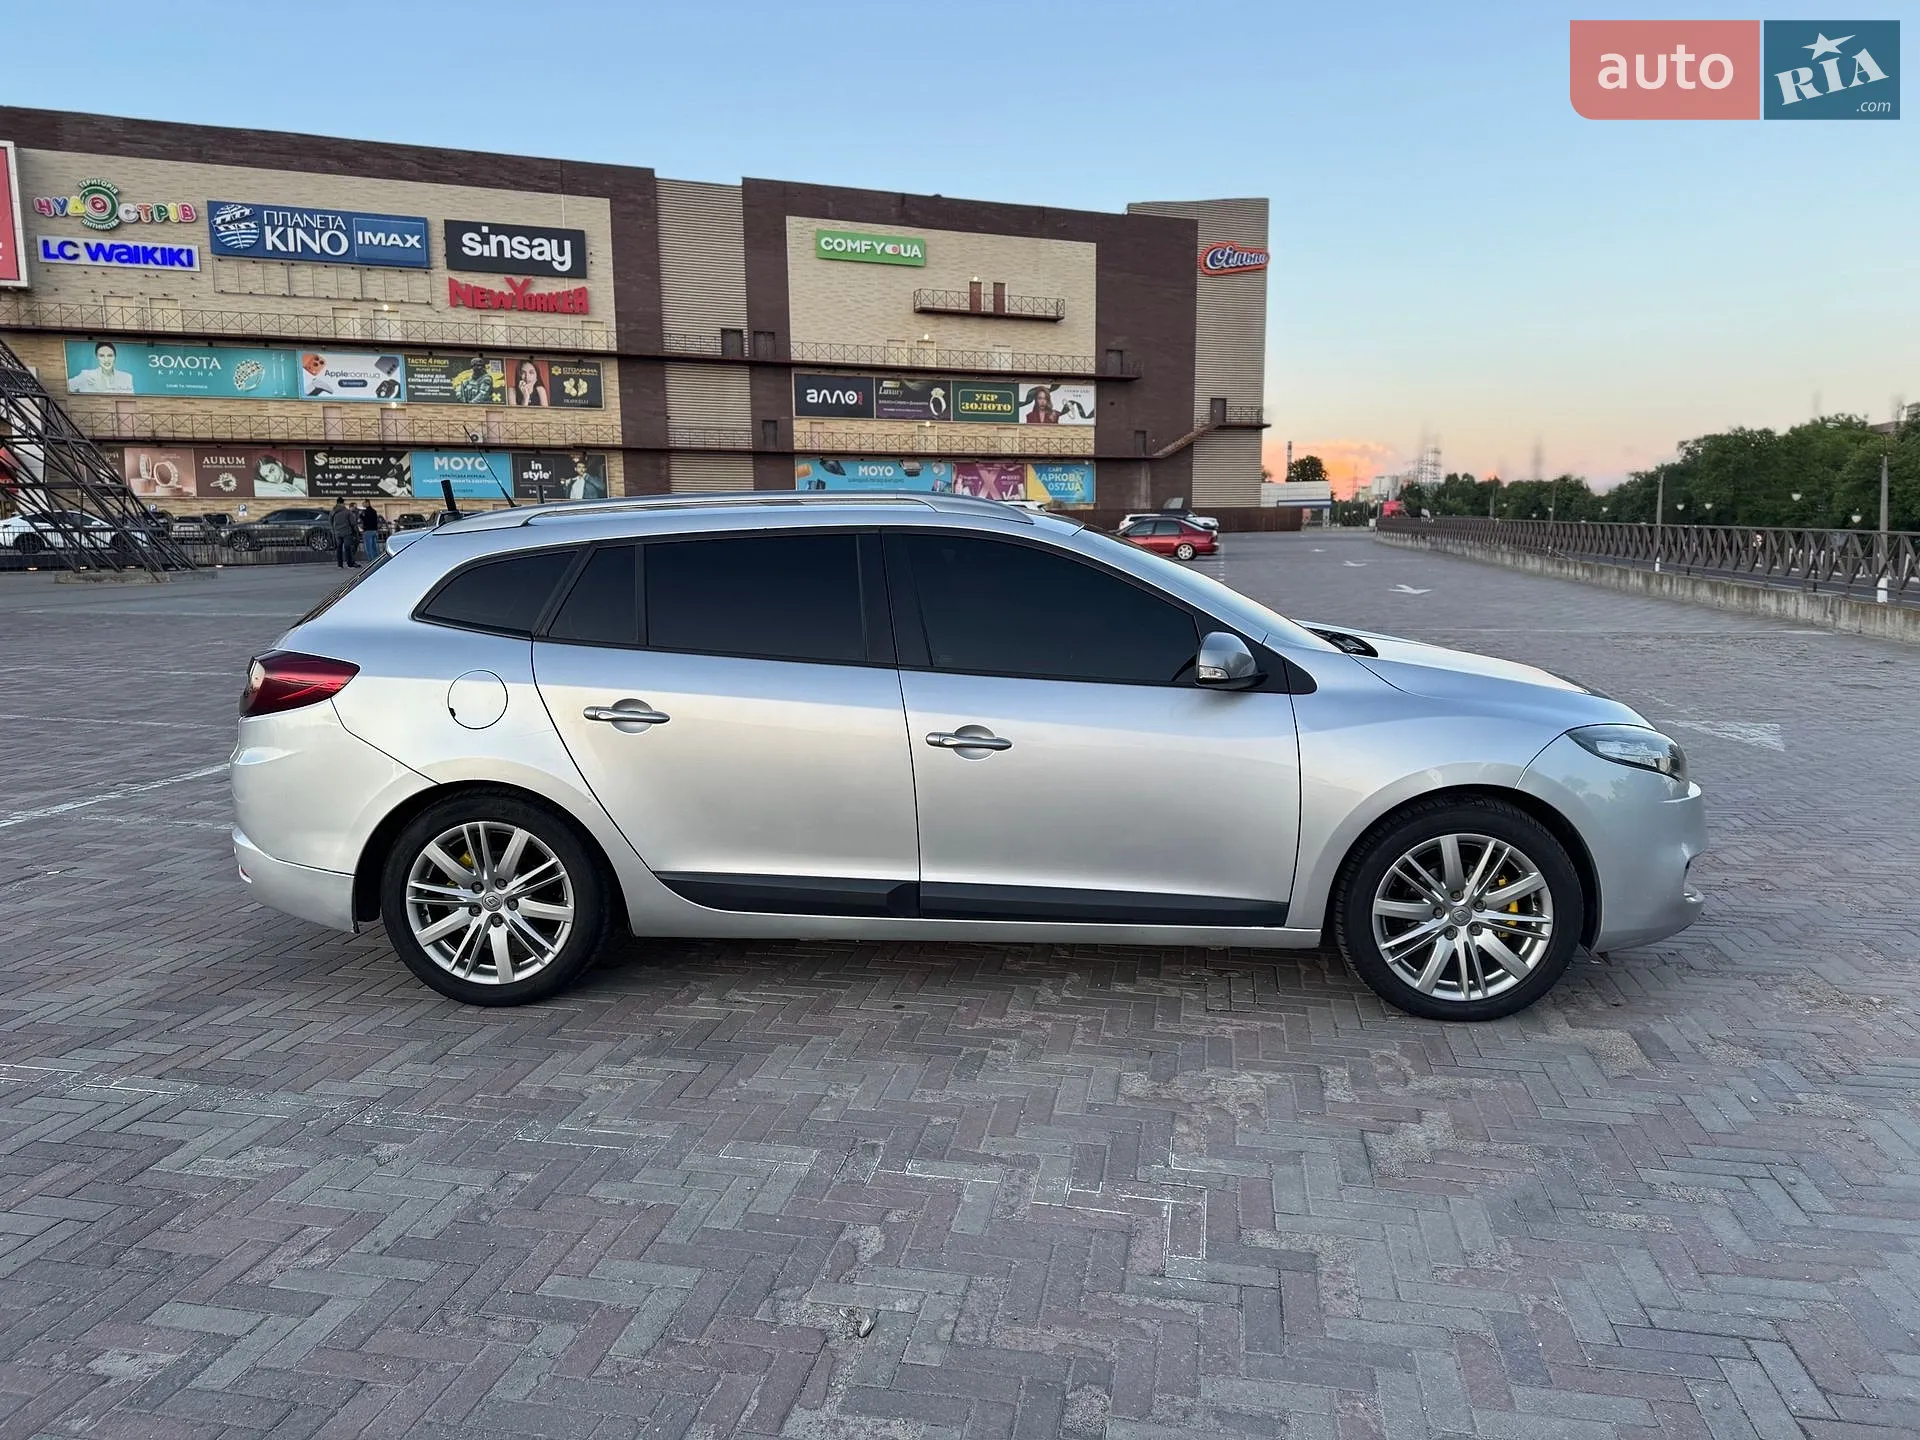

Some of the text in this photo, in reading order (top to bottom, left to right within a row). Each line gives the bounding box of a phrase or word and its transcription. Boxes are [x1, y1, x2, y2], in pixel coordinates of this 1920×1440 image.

[264, 226, 349, 256] KINO
[357, 231, 422, 249] IMAX
[42, 239, 80, 260] LC
[461, 226, 573, 272] sinsay
[148, 355, 222, 370] ЗОЛОТА
[975, 393, 998, 401] УКР
[961, 402, 1012, 412] ЗОЛОТО
[202, 456, 246, 465] AURUM
[328, 456, 384, 465] SPORTCITY
[434, 456, 488, 471] MOYO
[531, 460, 542, 470] in
[858, 465, 895, 477] MOYO
